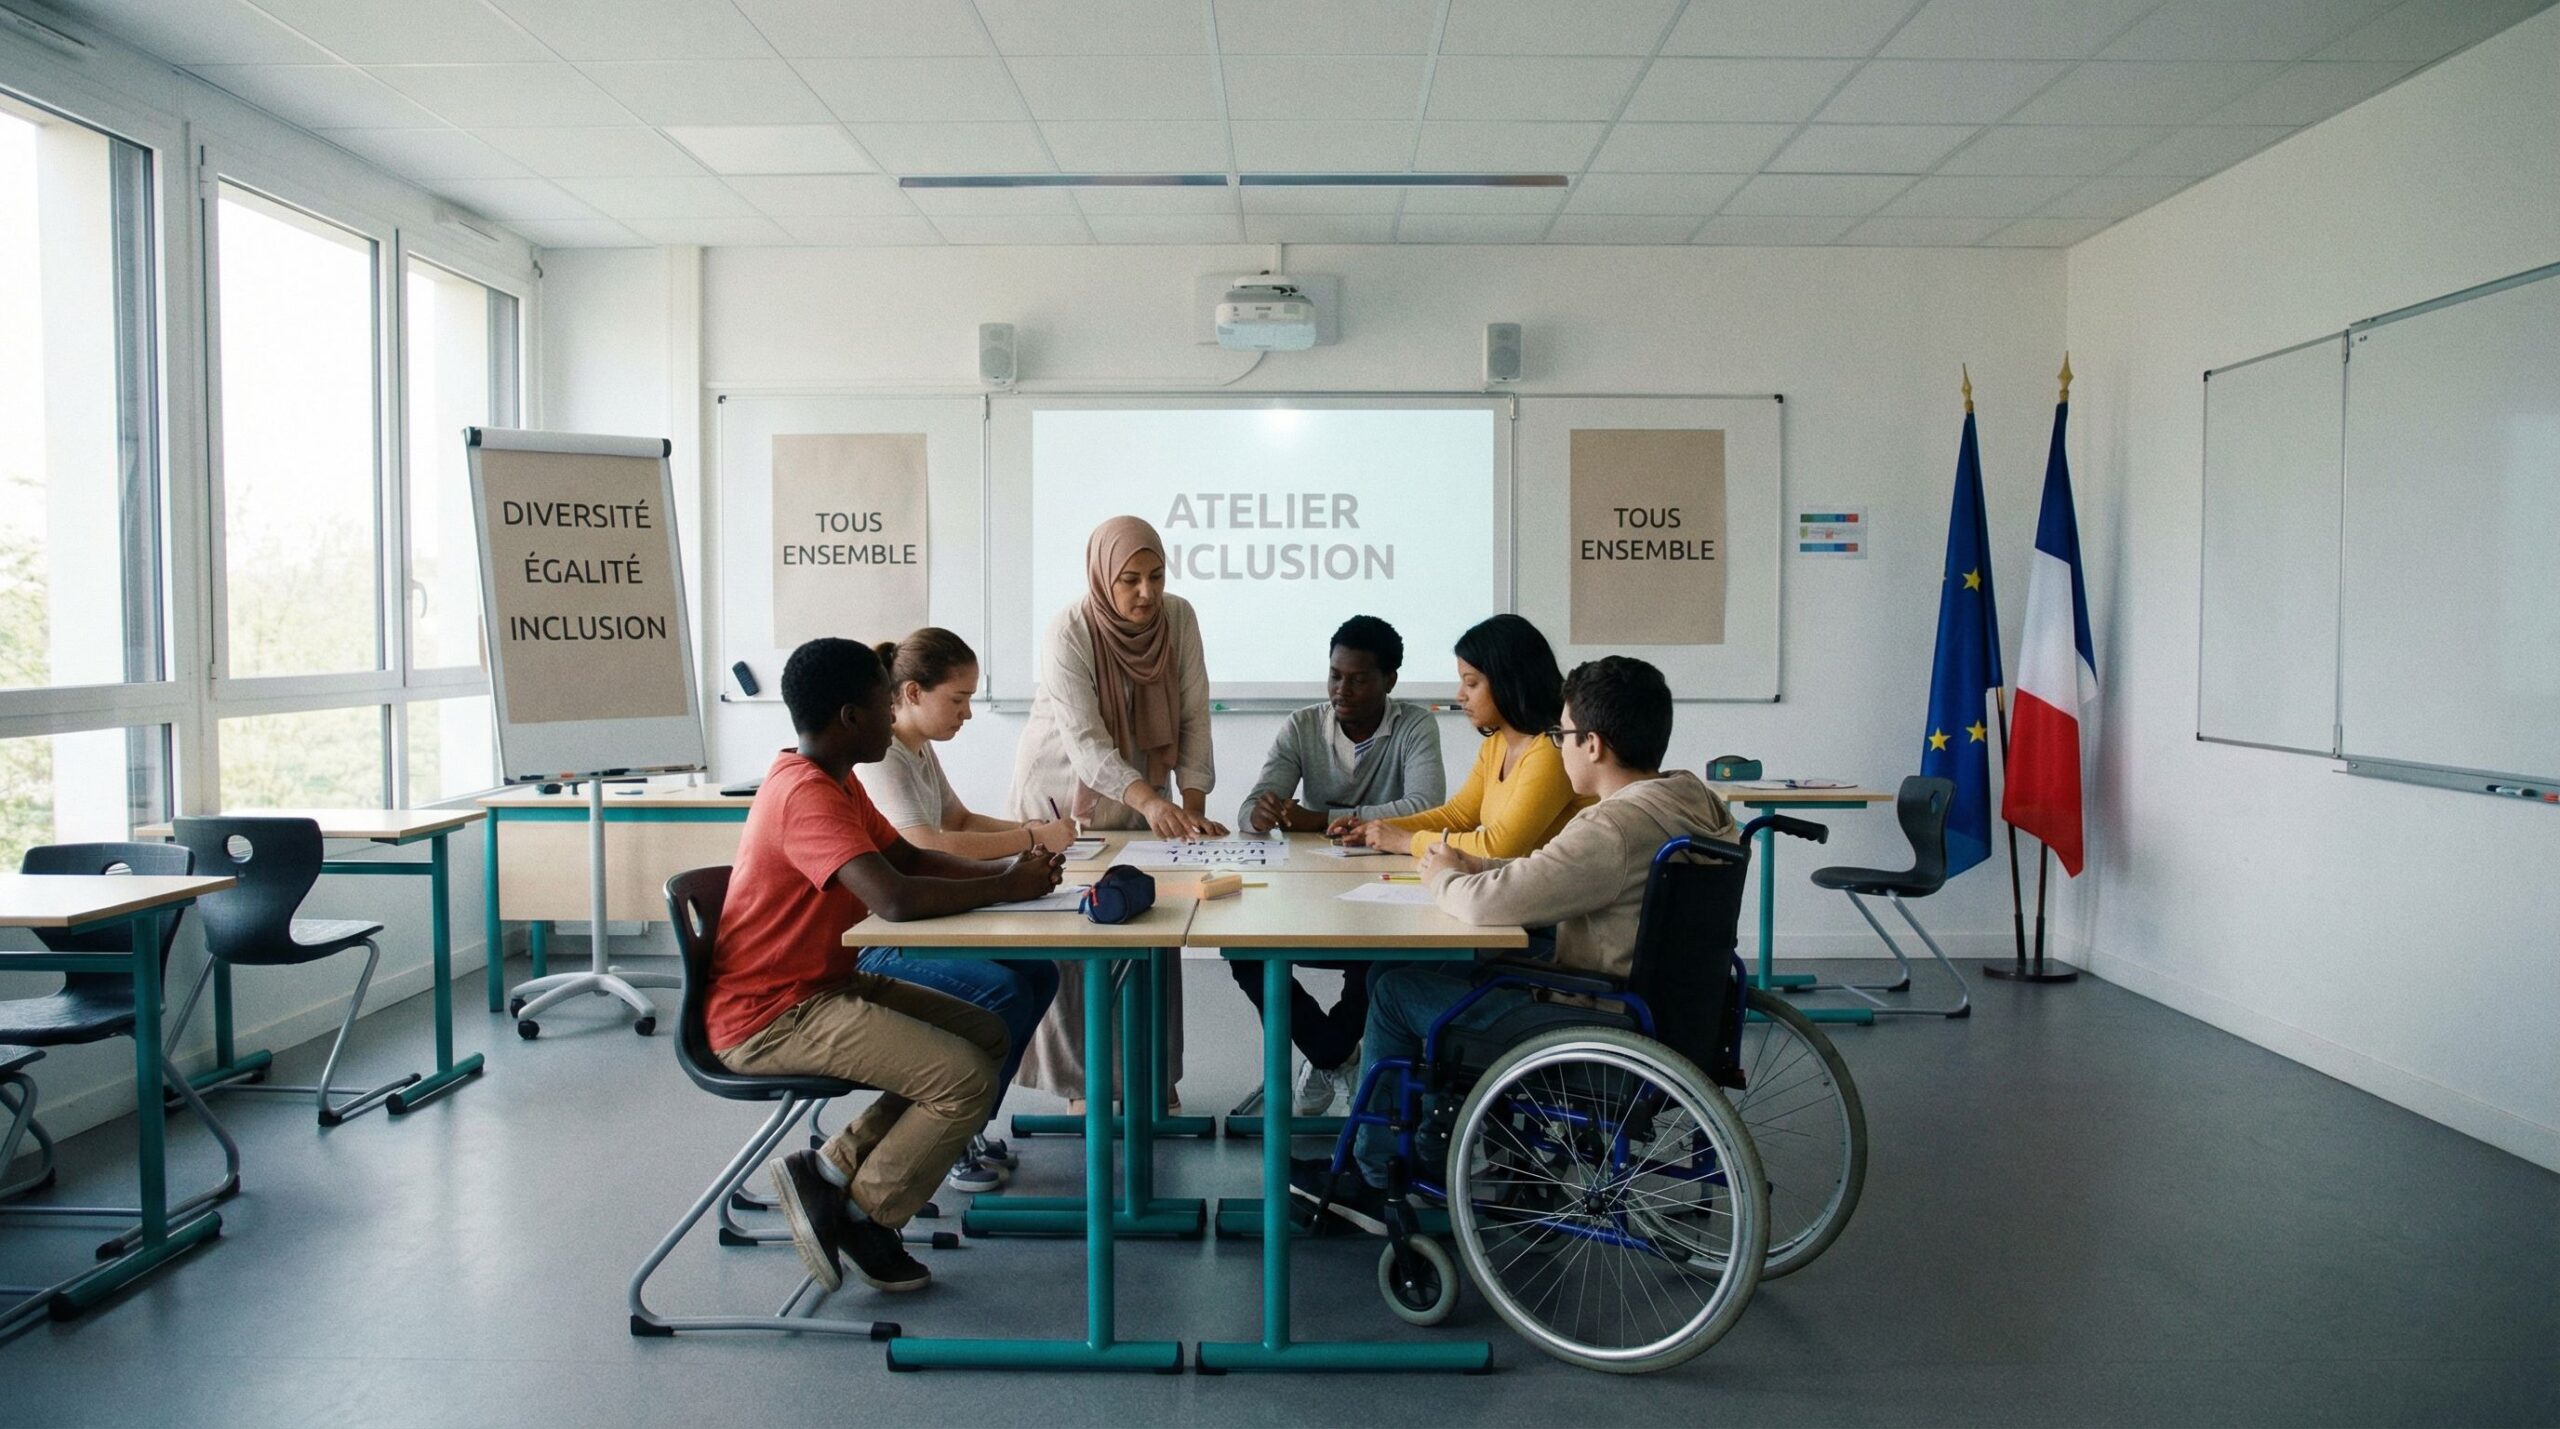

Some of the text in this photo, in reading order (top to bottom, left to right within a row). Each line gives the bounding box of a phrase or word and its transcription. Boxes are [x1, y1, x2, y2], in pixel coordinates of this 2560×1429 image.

[503, 498, 653, 529] DIVERSITÉ
[815, 511, 883, 533] TOUS
[1164, 492, 1361, 530] ATELIER
[1613, 507, 1682, 529] TOUS
[783, 543, 919, 566] ENSEMBLE
[1166, 543, 1395, 581] NCLUSION
[1581, 539, 1715, 561] ENSEMBLE
[524, 550, 644, 585] ÉGALITÉ
[510, 615, 667, 641] INCLUSION
